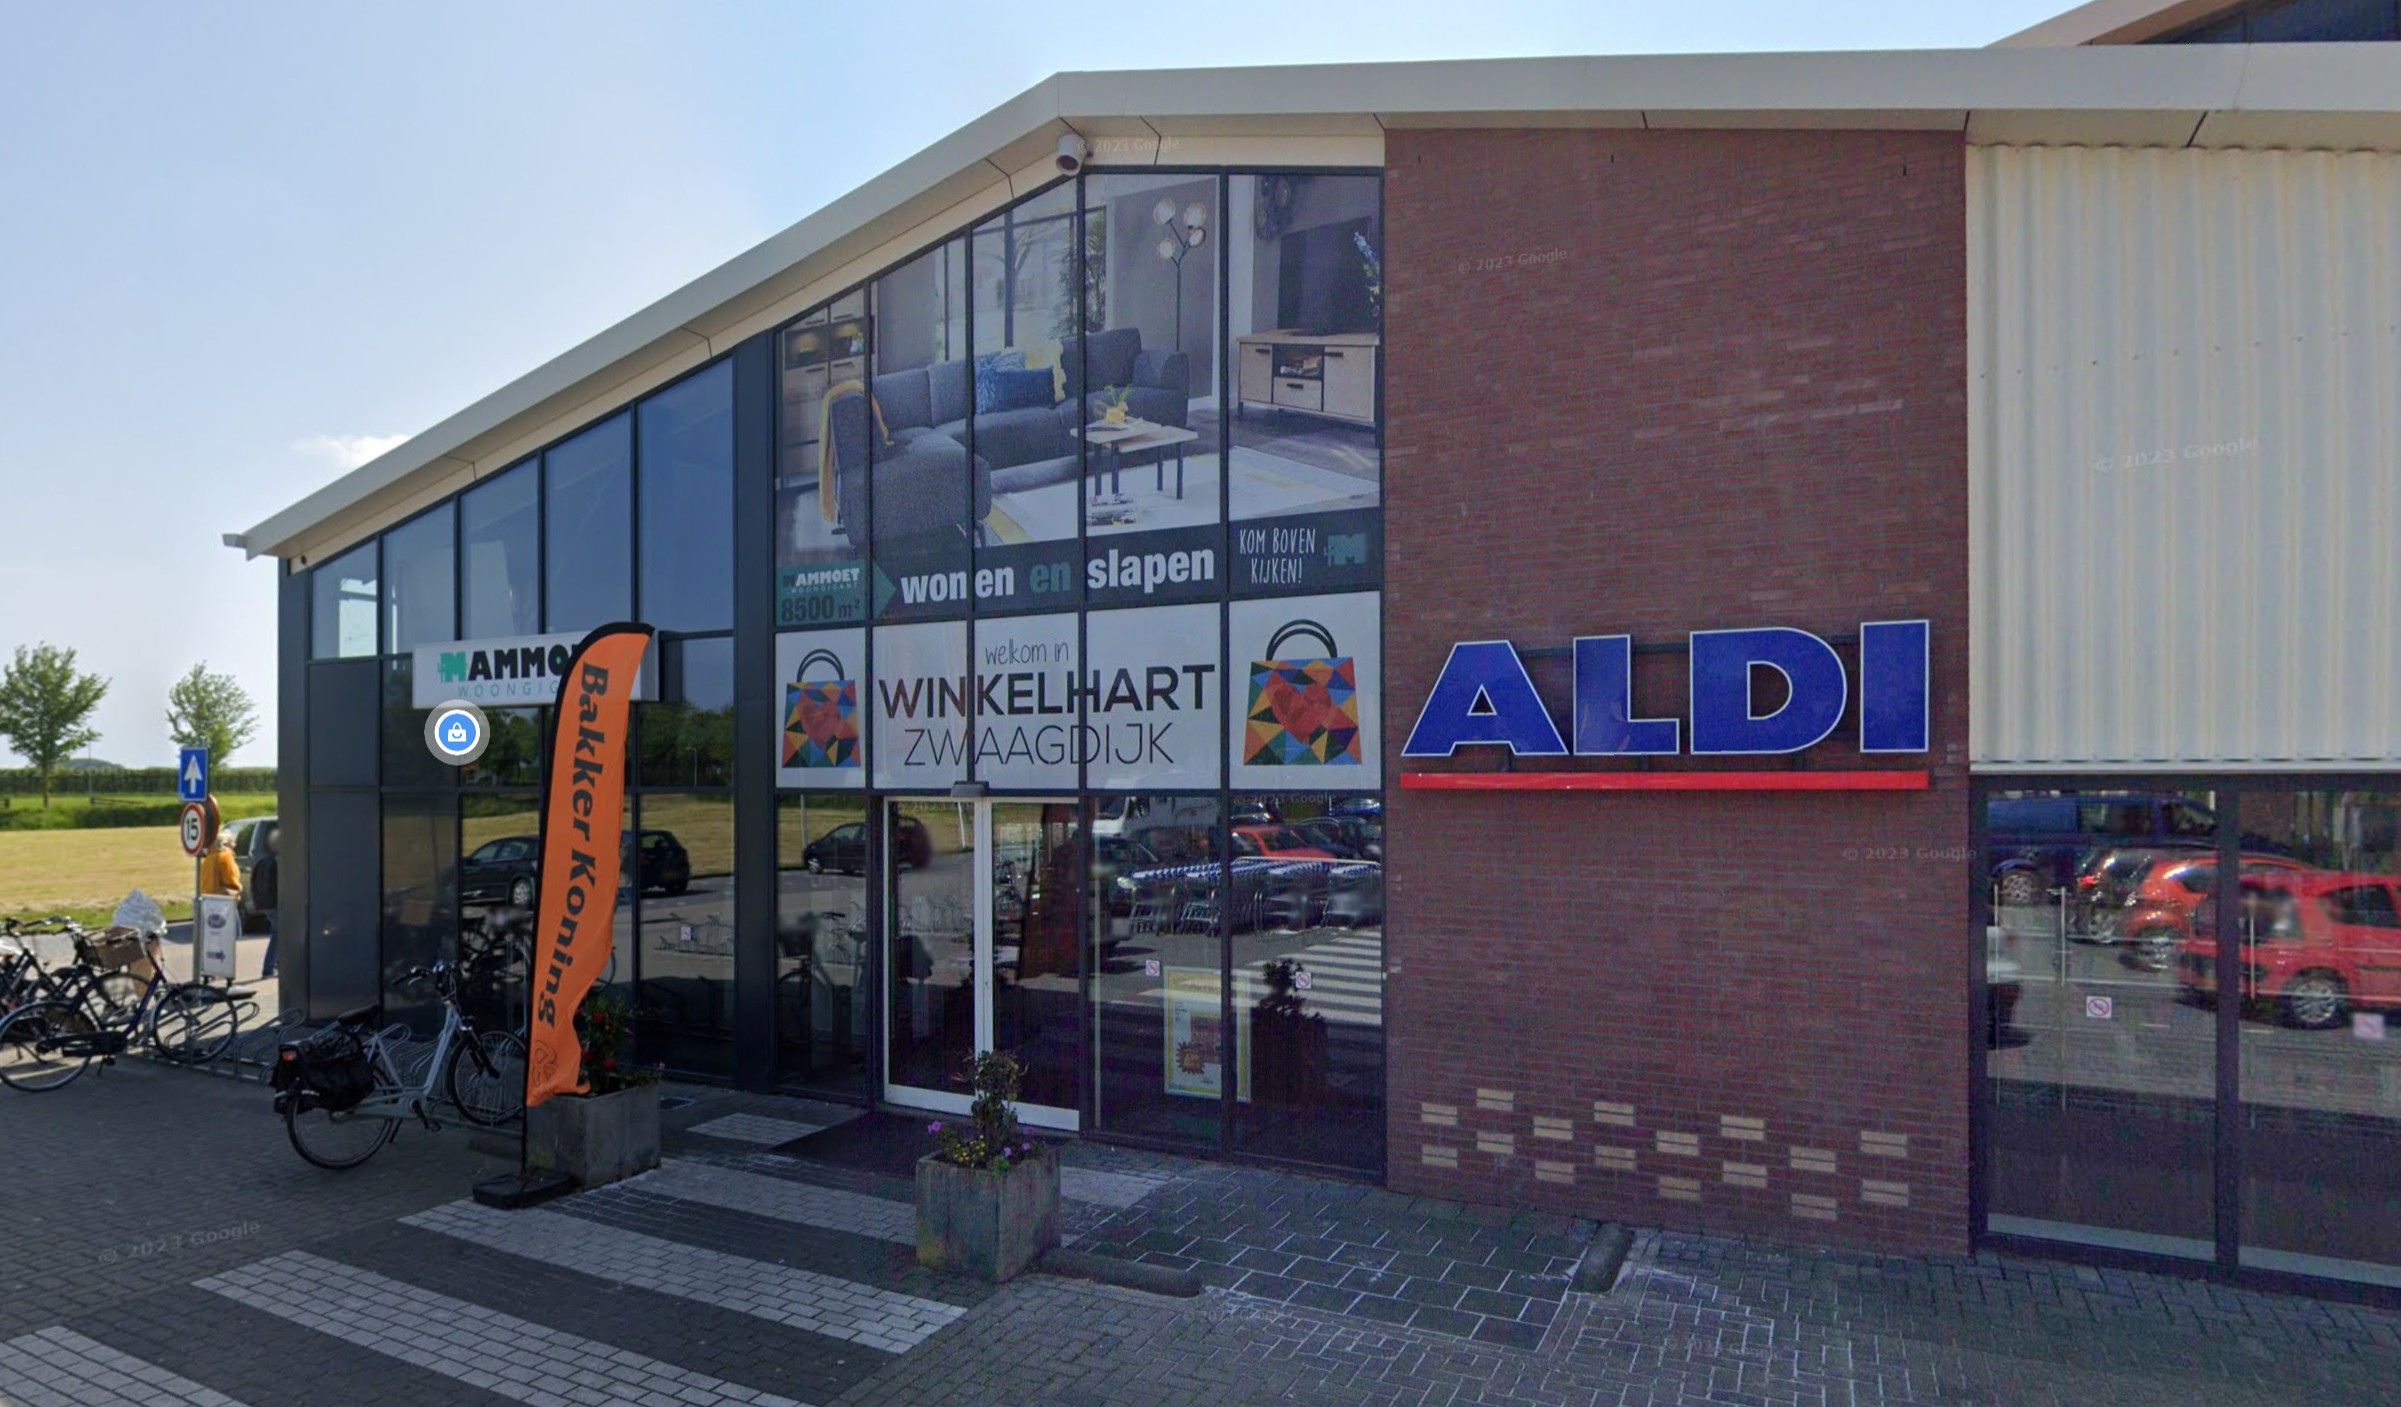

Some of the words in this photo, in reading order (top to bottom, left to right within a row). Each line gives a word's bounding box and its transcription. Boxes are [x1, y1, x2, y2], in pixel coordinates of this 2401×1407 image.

[1239, 529, 1265, 554] KOM
[1272, 527, 1316, 555] BOVEN
[901, 566, 1015, 604] wonen
[1029, 562, 1070, 593] en
[1087, 549, 1215, 594] slapen
[1251, 557, 1303, 584] KIJKEN!
[782, 595, 834, 622] 8500
[438, 644, 578, 683] MAMMO
[985, 638, 1047, 666] welkom
[1054, 639, 1069, 663] in
[878, 664, 1215, 719] WINKELHART
[1401, 619, 1929, 755] ALDI
[572, 661, 609, 843] Bakker
[904, 722, 1175, 766] ZWAAGDIJK
[187, 818, 199, 841] 15
[538, 848, 597, 1027] Koning
